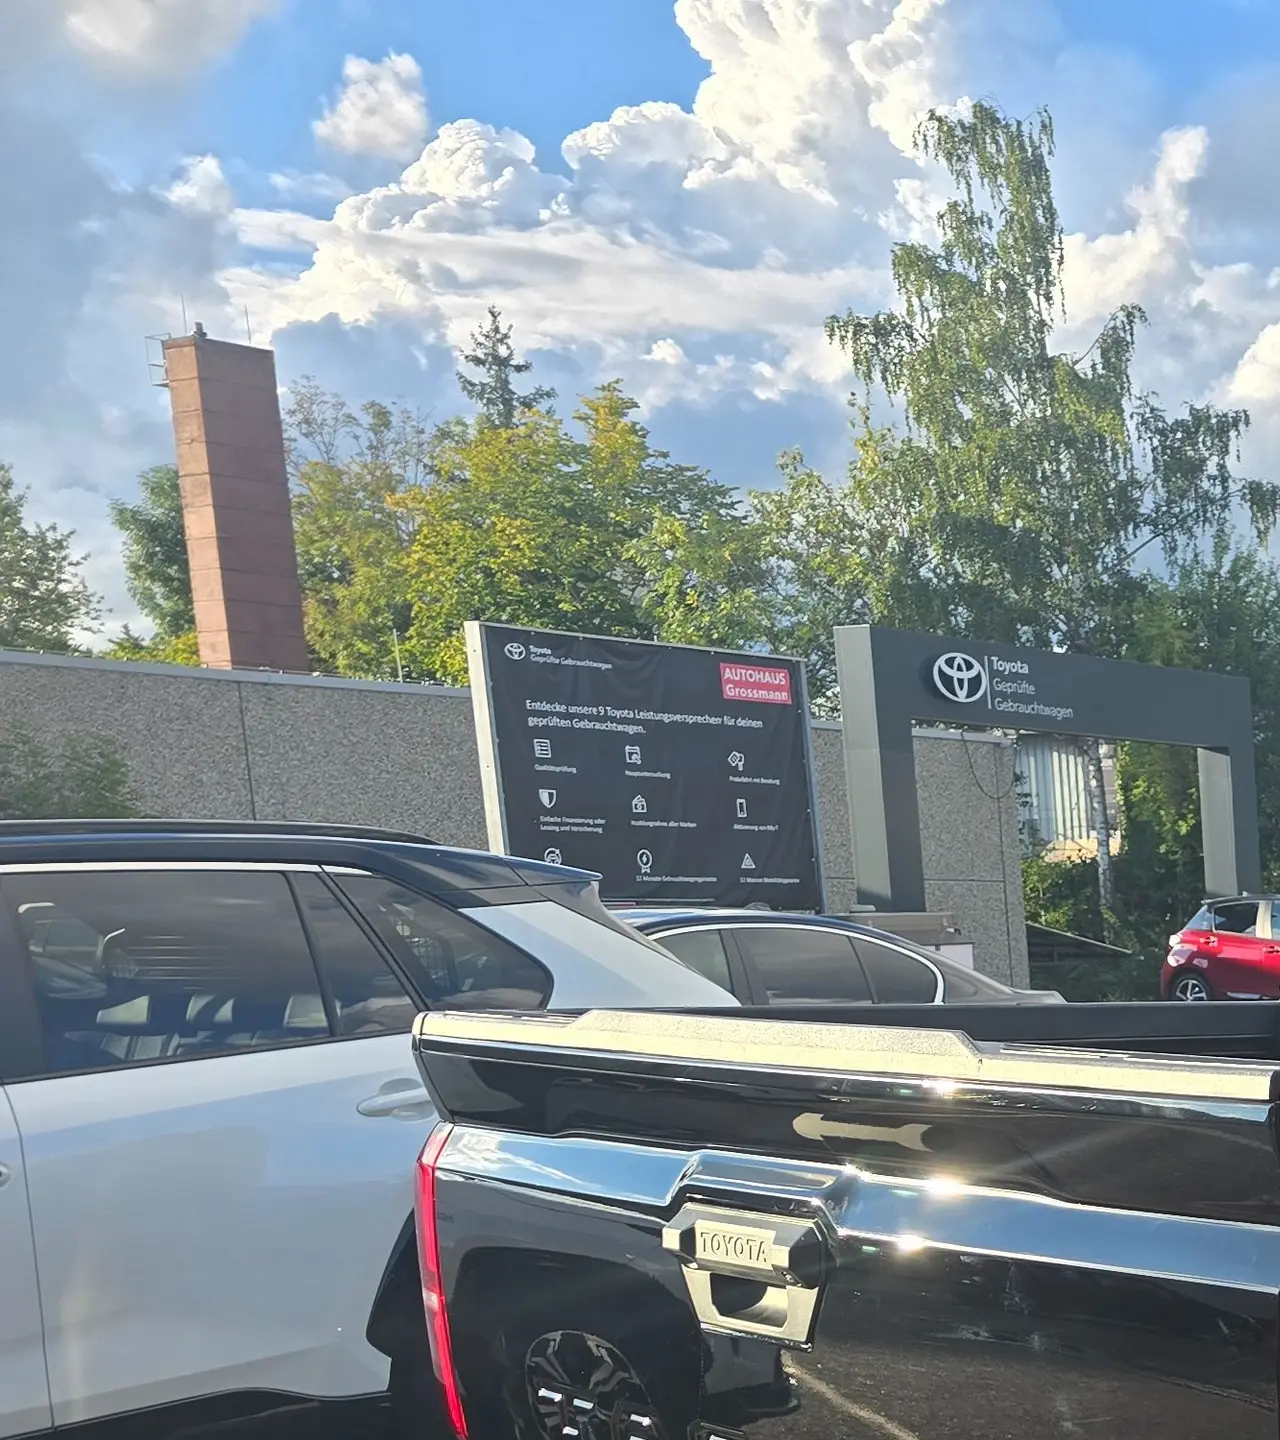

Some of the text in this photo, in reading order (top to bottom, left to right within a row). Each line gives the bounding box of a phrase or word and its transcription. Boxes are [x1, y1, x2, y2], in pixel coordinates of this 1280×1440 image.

[529, 645, 551, 655] Toyota
[530, 654, 613, 670] Geprüfte Gebrauchtwagen
[991, 656, 1029, 675] Toyota
[724, 667, 786, 685] AUTOHAUS
[726, 684, 788, 700] Grossmann
[993, 678, 1036, 695] Geprüfte
[526, 700, 567, 713] Entdecke
[568, 705, 598, 715] unsere
[598, 706, 605, 715] 9
[606, 707, 634, 719] Toyota
[723, 715, 736, 725] für
[736, 717, 763, 728] deinen
[995, 698, 1074, 720] Gebrauchtwagen
[527, 716, 646, 734] geprüften Gebrauchtwagen.
[700, 1231, 768, 1263] TOYOTA
